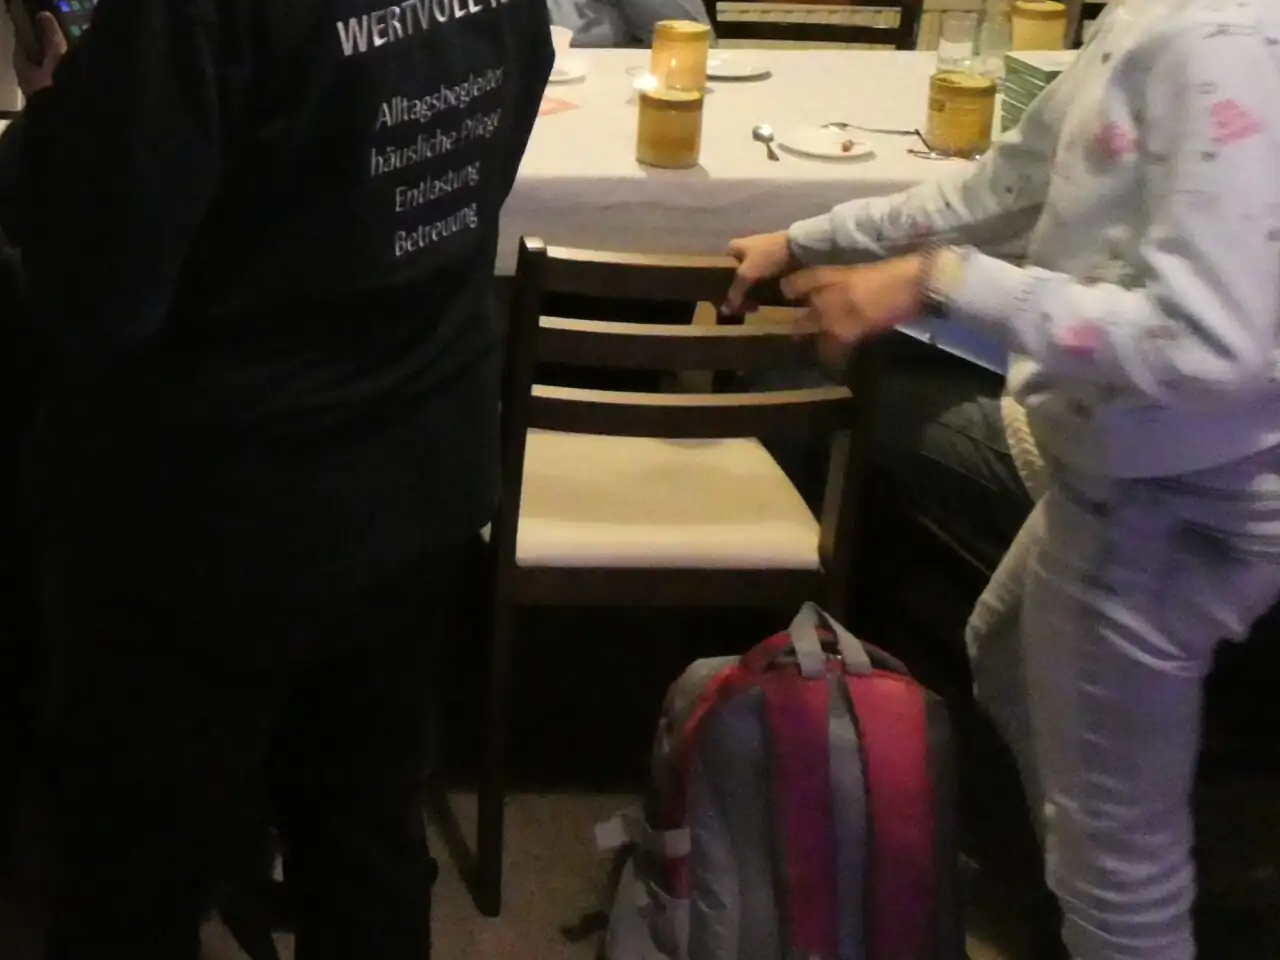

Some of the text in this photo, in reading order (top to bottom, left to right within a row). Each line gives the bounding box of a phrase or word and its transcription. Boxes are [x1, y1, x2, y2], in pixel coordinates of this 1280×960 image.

[375, 65, 506, 133] Alltagsbegleiter
[368, 129, 457, 178] häusliche
[394, 159, 482, 213] Entlastung
[394, 202, 479, 257] Betreuung
